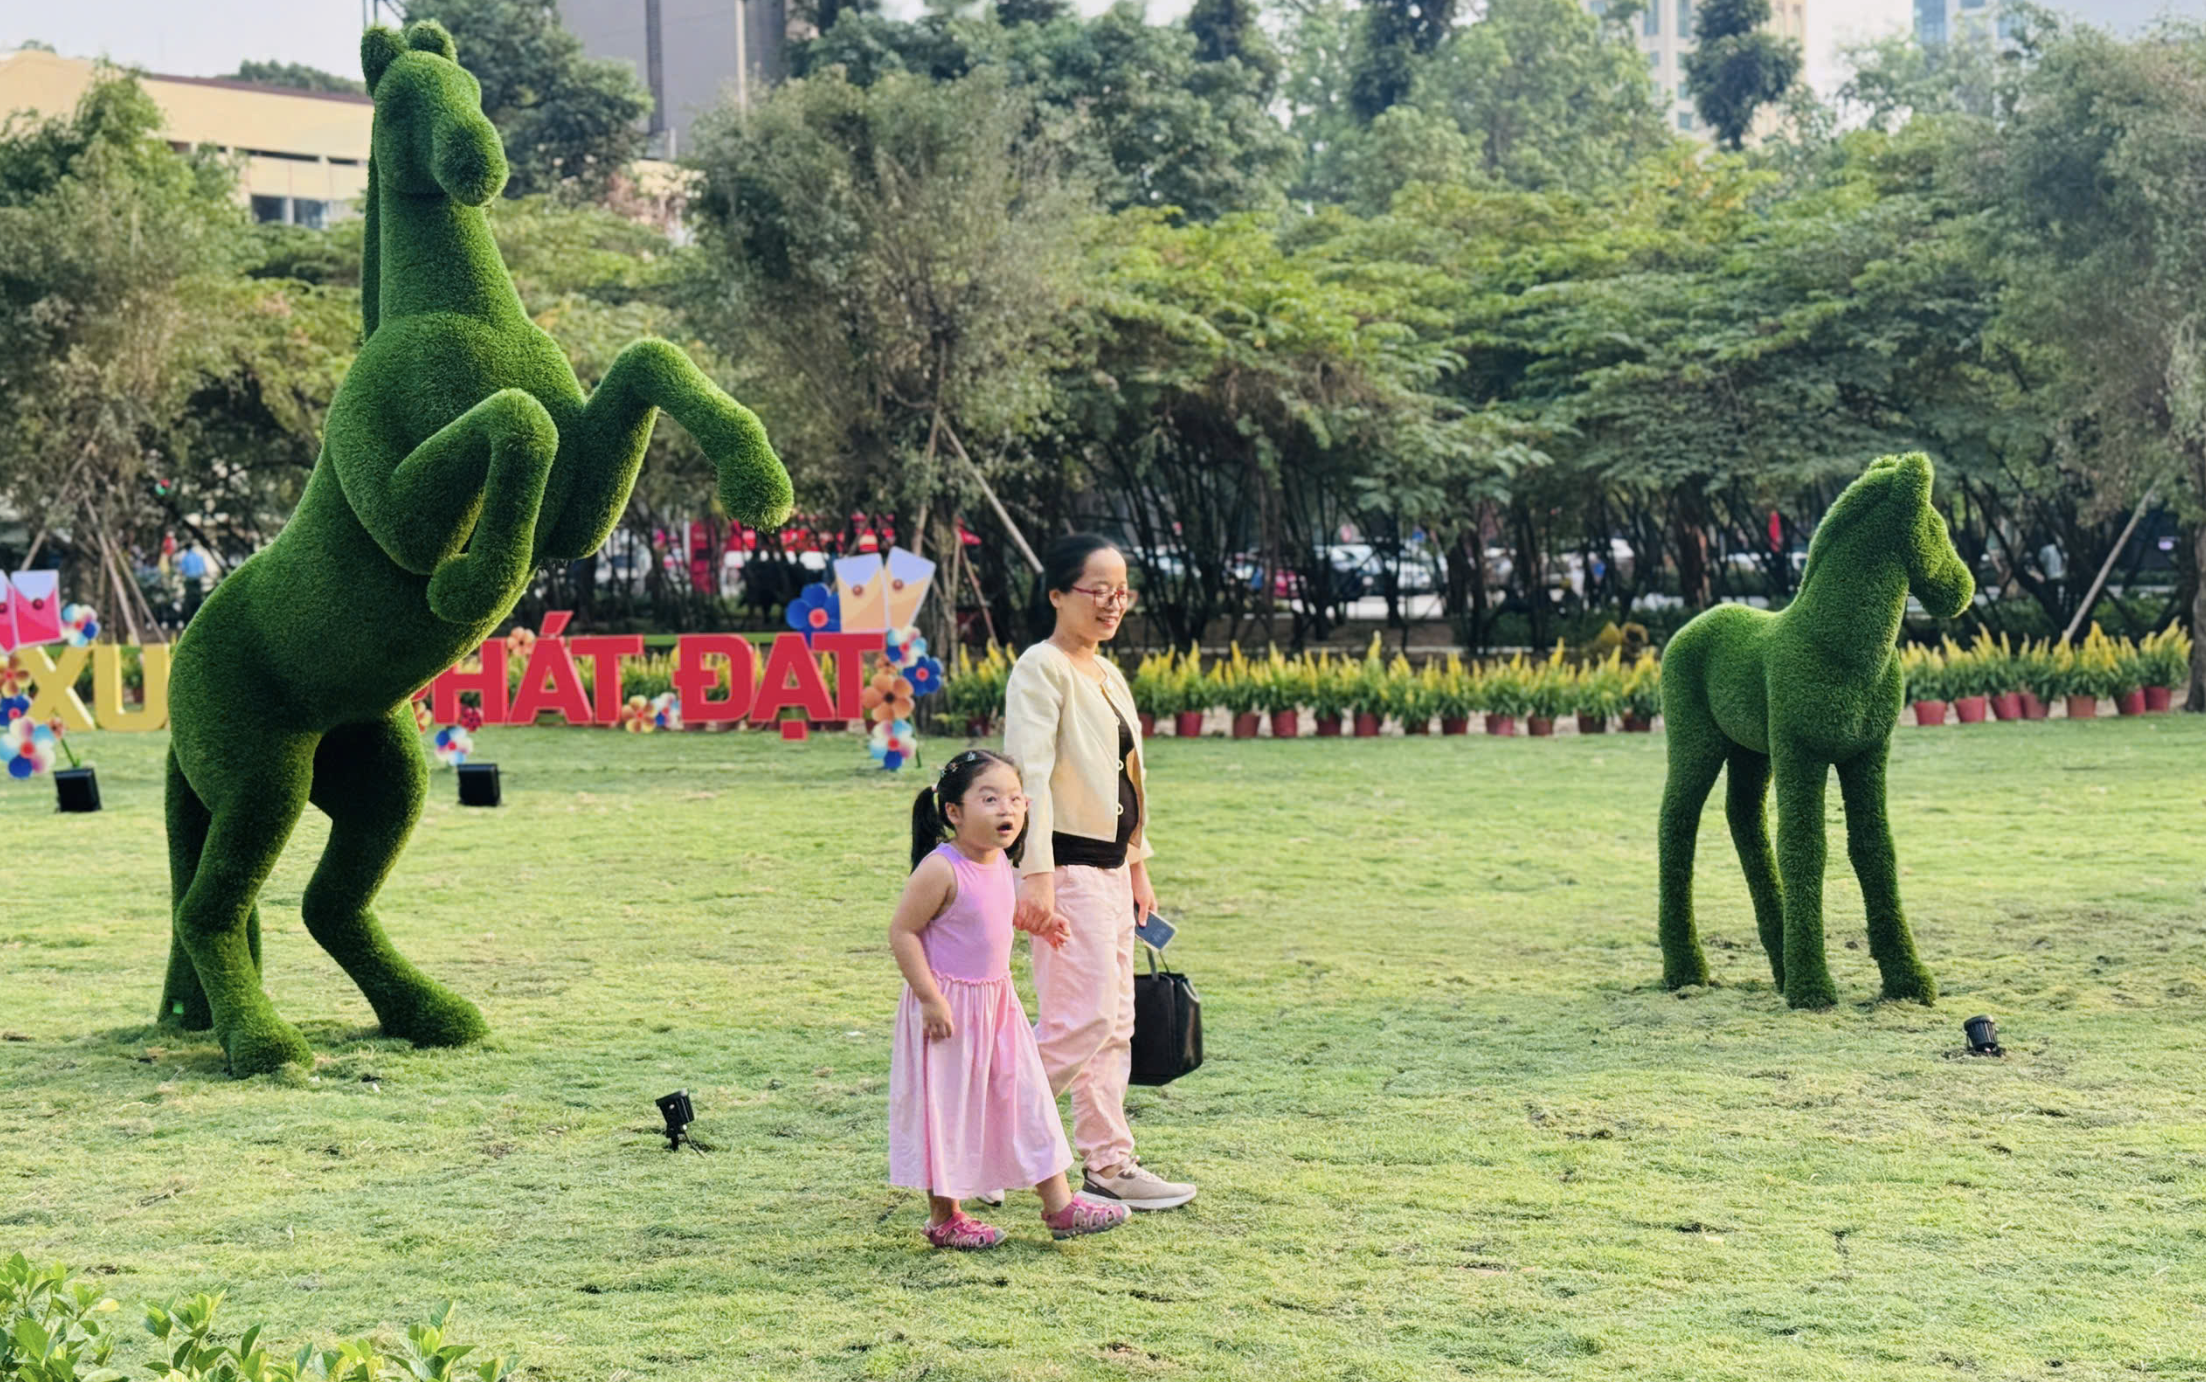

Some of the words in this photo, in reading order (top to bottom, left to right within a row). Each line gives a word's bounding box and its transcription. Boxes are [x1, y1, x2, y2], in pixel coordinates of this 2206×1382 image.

[16, 643, 170, 732] XU
[411, 611, 644, 725] HÁT
[672, 632, 886, 741] ĐẠT
